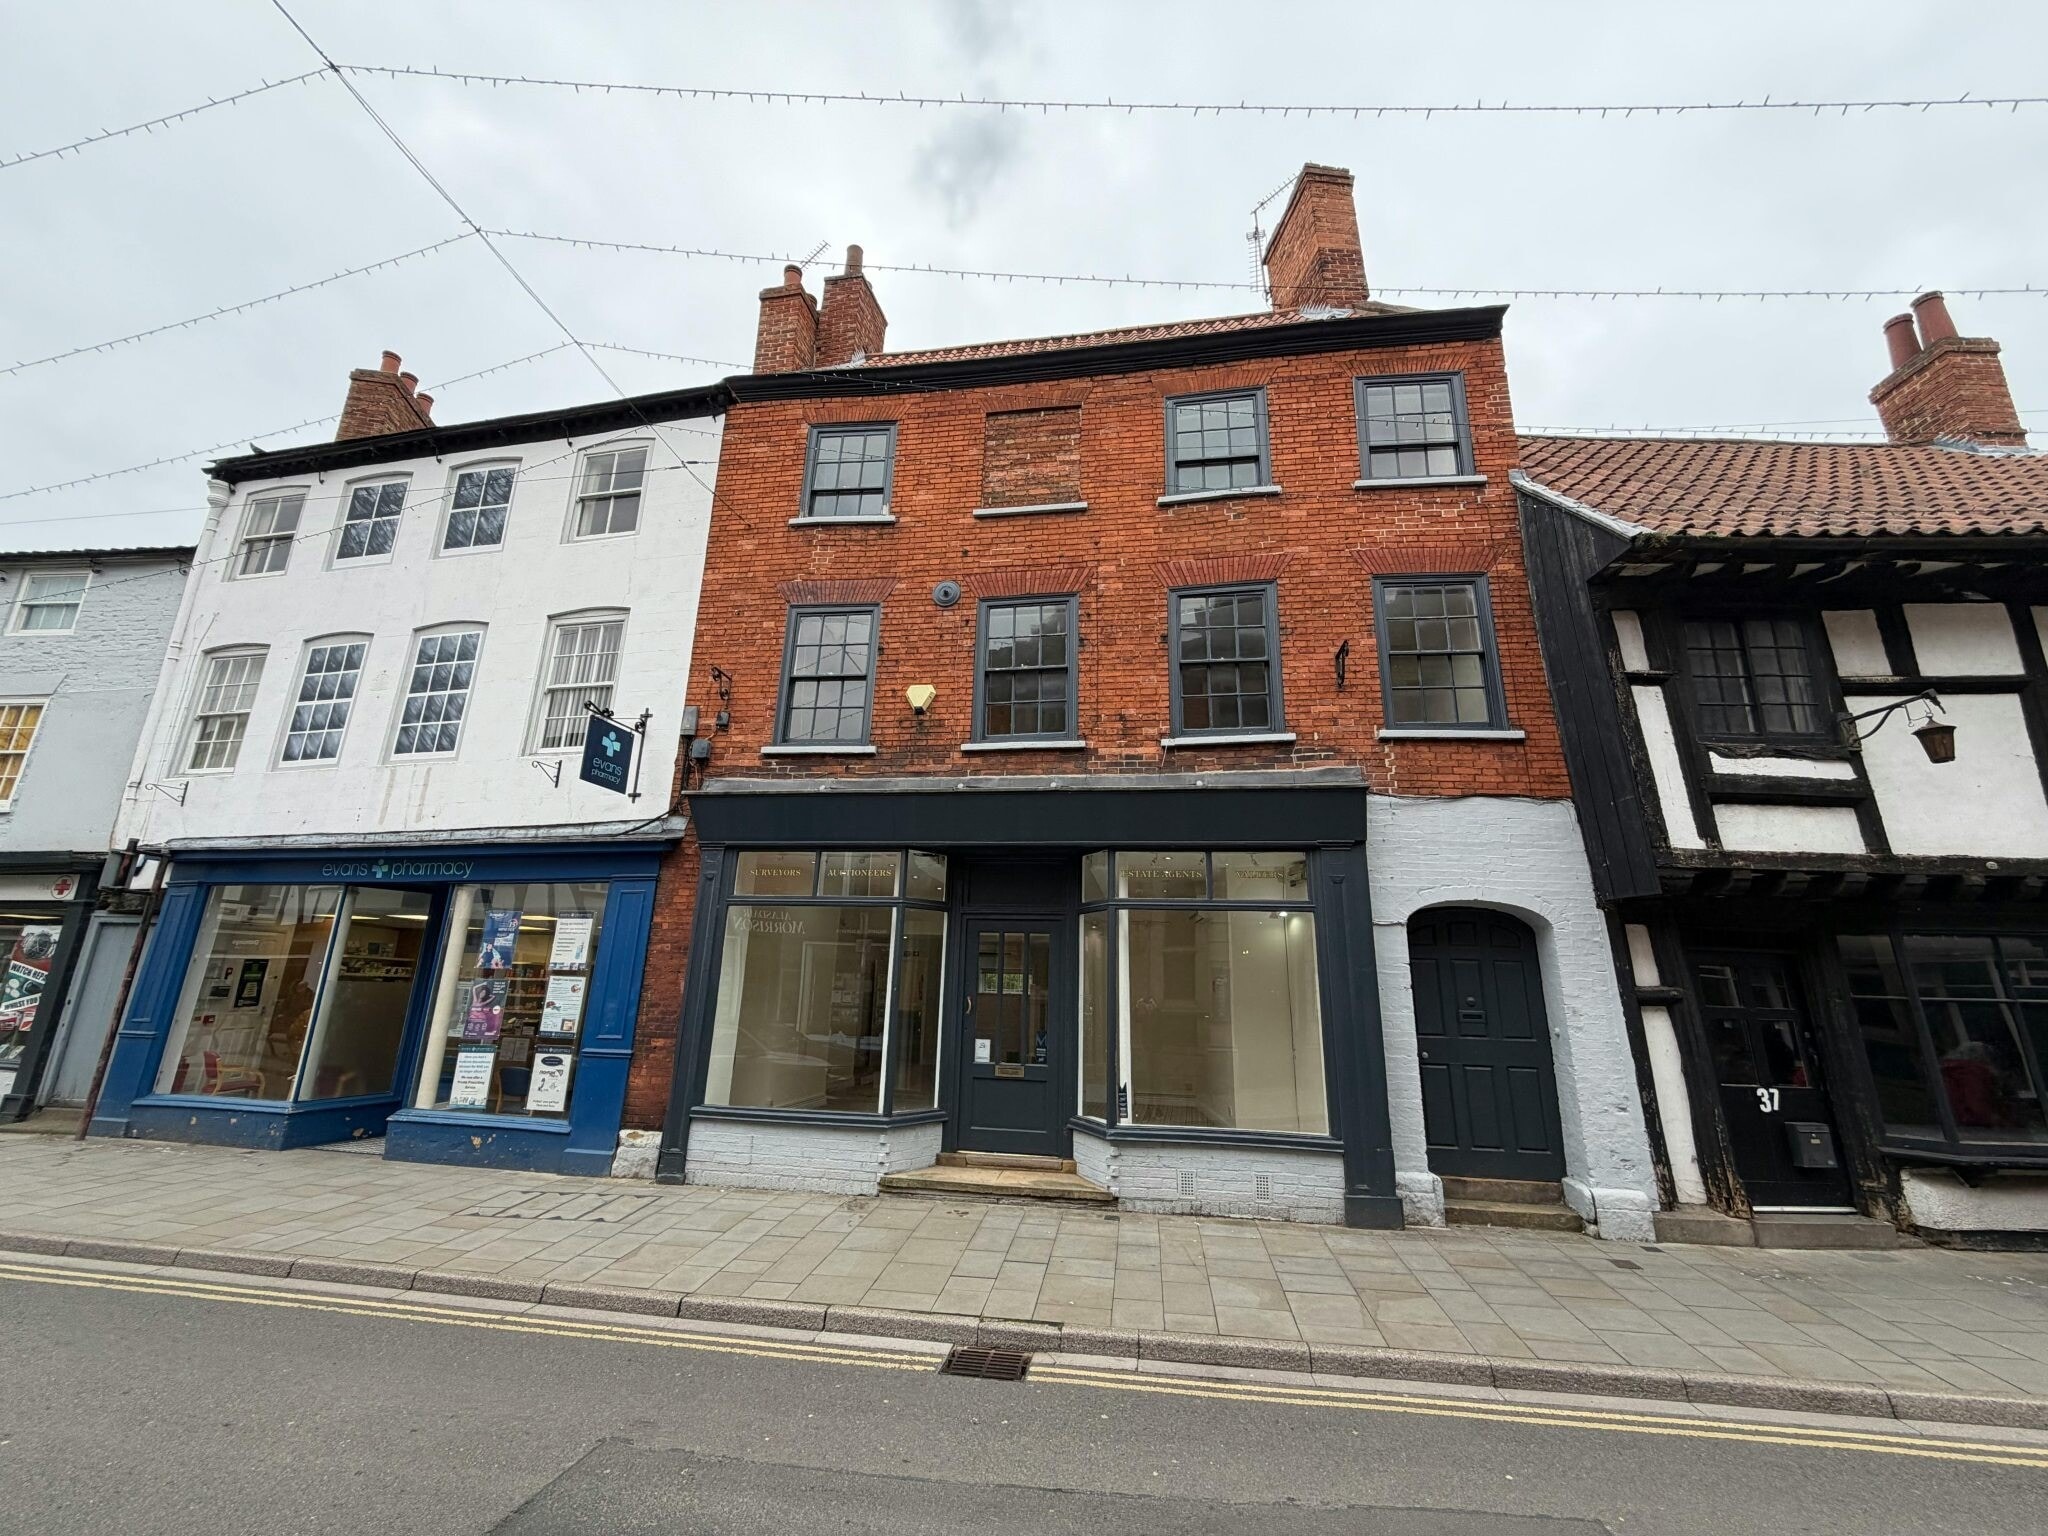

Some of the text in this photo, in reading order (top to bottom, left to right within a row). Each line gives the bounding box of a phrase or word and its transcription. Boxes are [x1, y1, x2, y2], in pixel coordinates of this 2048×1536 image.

[592, 757, 622, 776] evans
[591, 768, 621, 785] pharmacy
[322, 859, 474, 879] evans pharmacy
[750, 868, 801, 877] SURVEYORS
[1120, 869, 1160, 878] ESTATE
[11, 963, 32, 977] WATCH
[1756, 1087, 1780, 1113] 37
